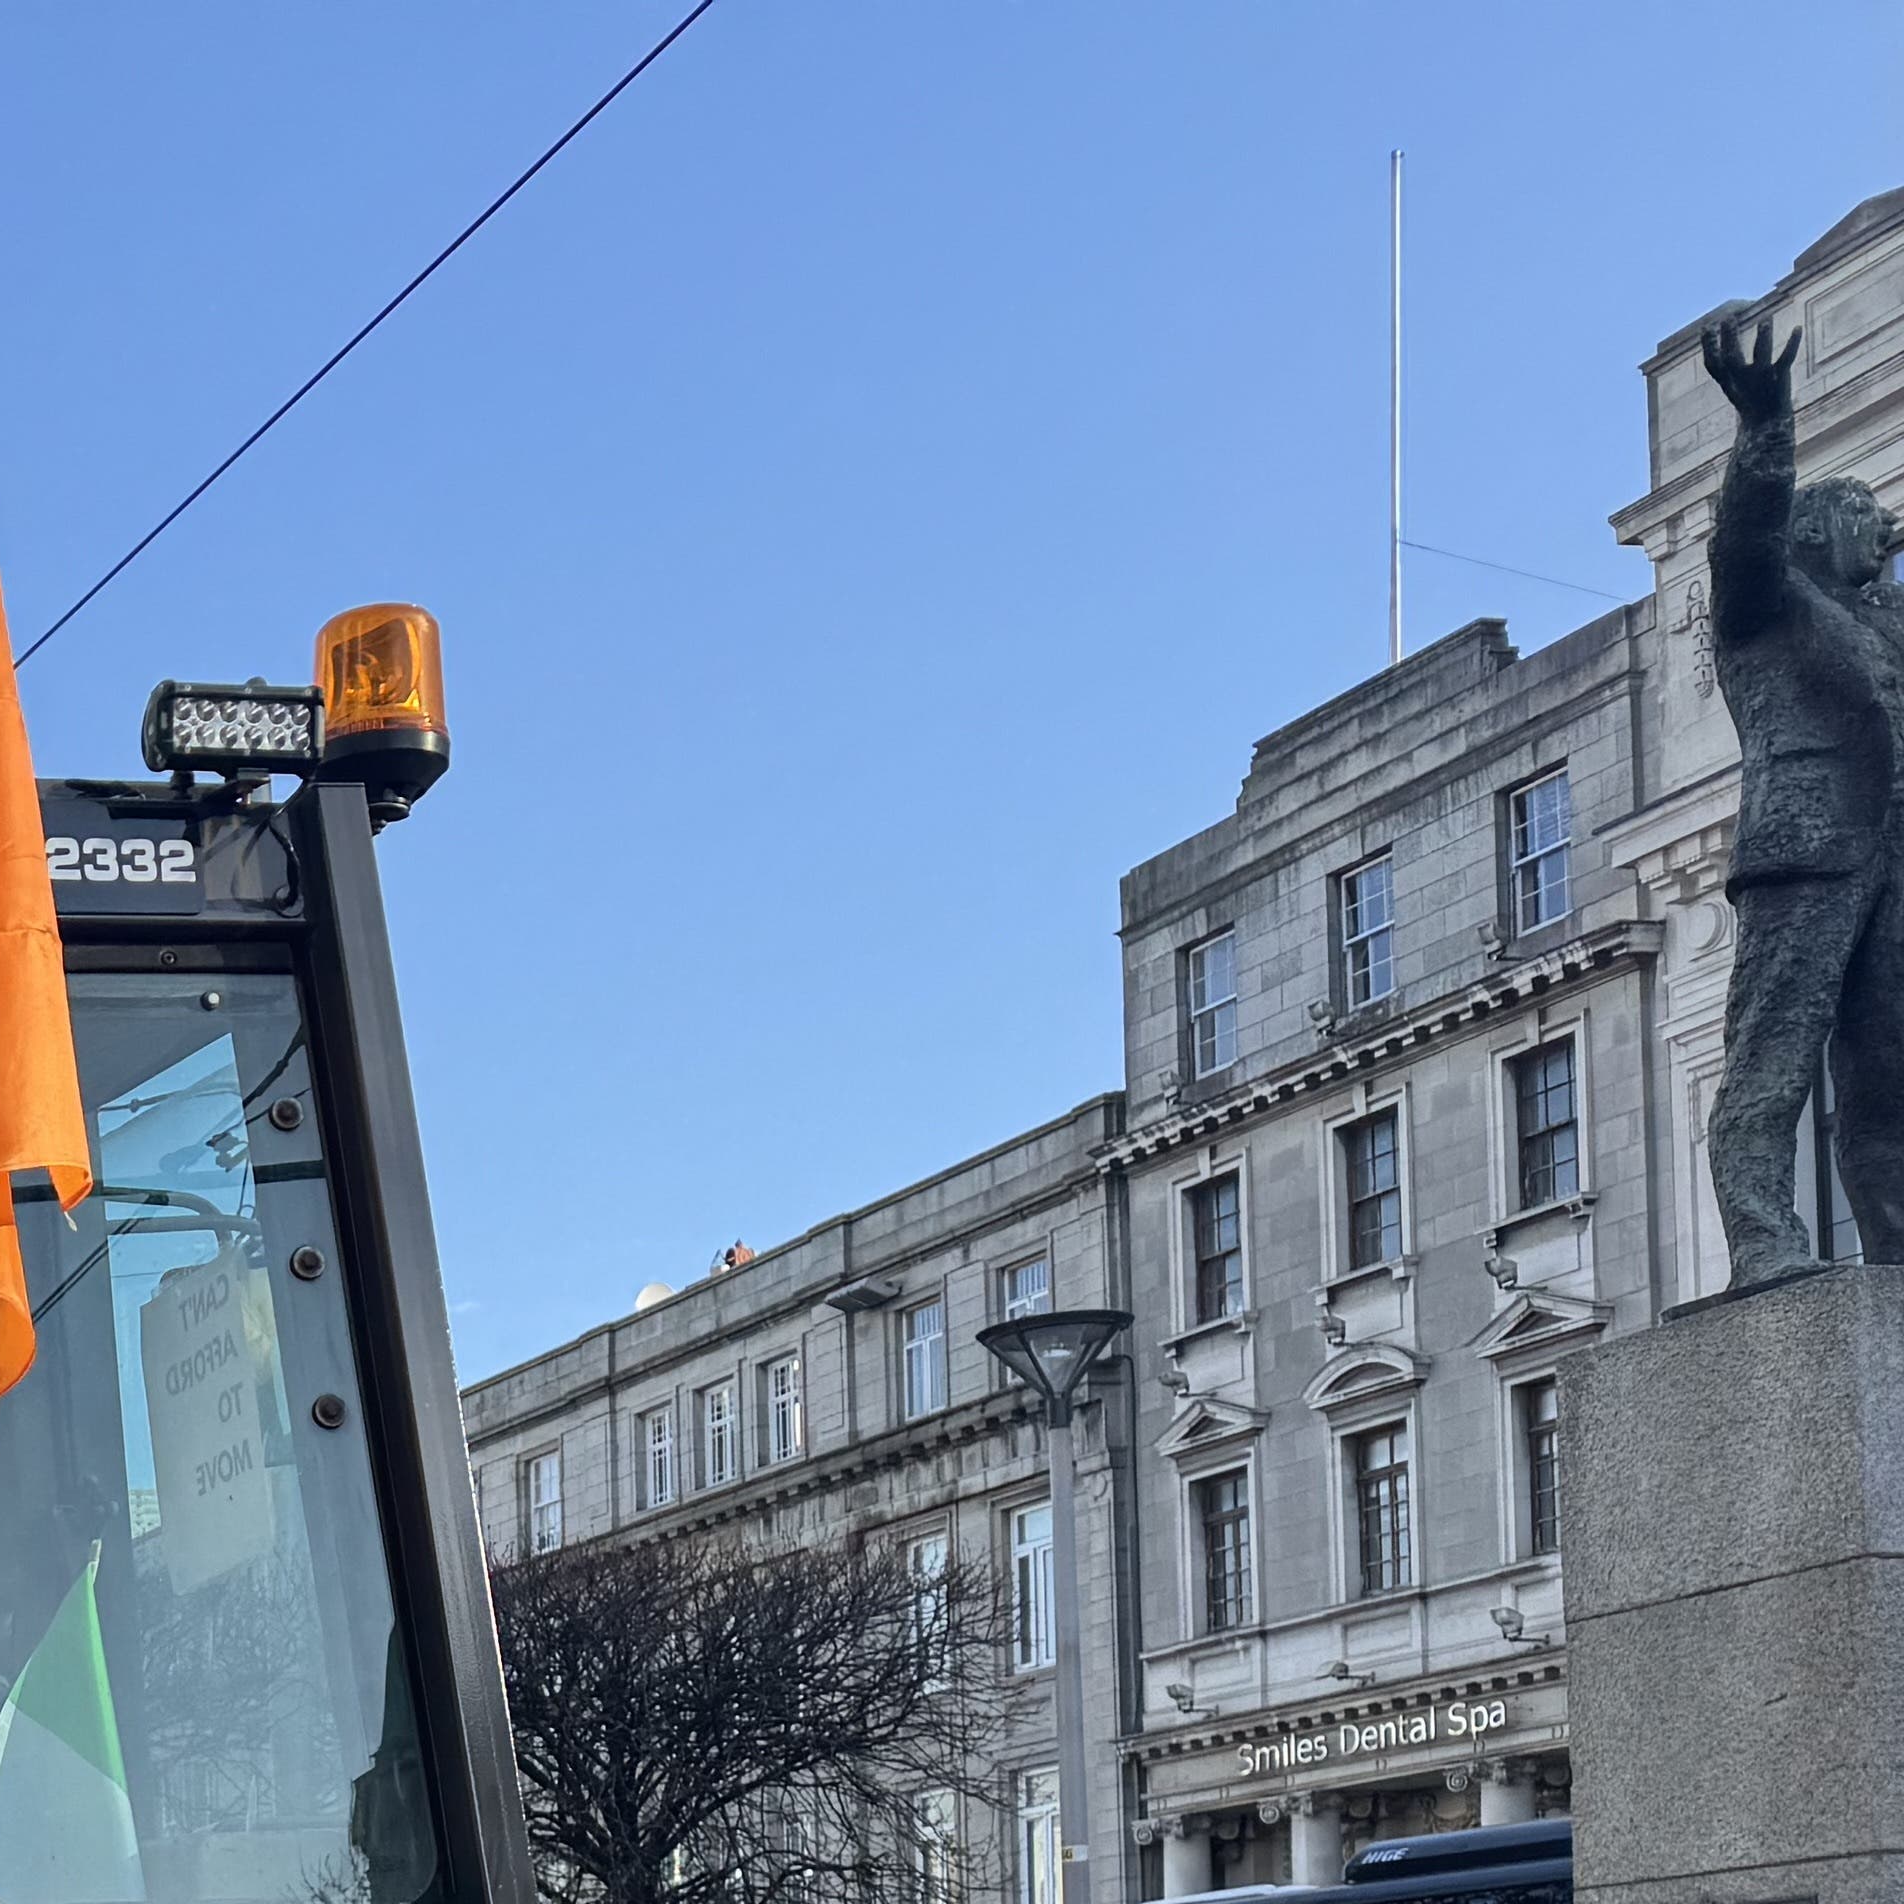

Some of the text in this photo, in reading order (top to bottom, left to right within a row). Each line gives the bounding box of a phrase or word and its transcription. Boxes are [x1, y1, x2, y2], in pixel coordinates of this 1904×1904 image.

[45, 837, 196, 882] 2332
[1237, 1700, 1506, 1776] Smiles Dental Spa
